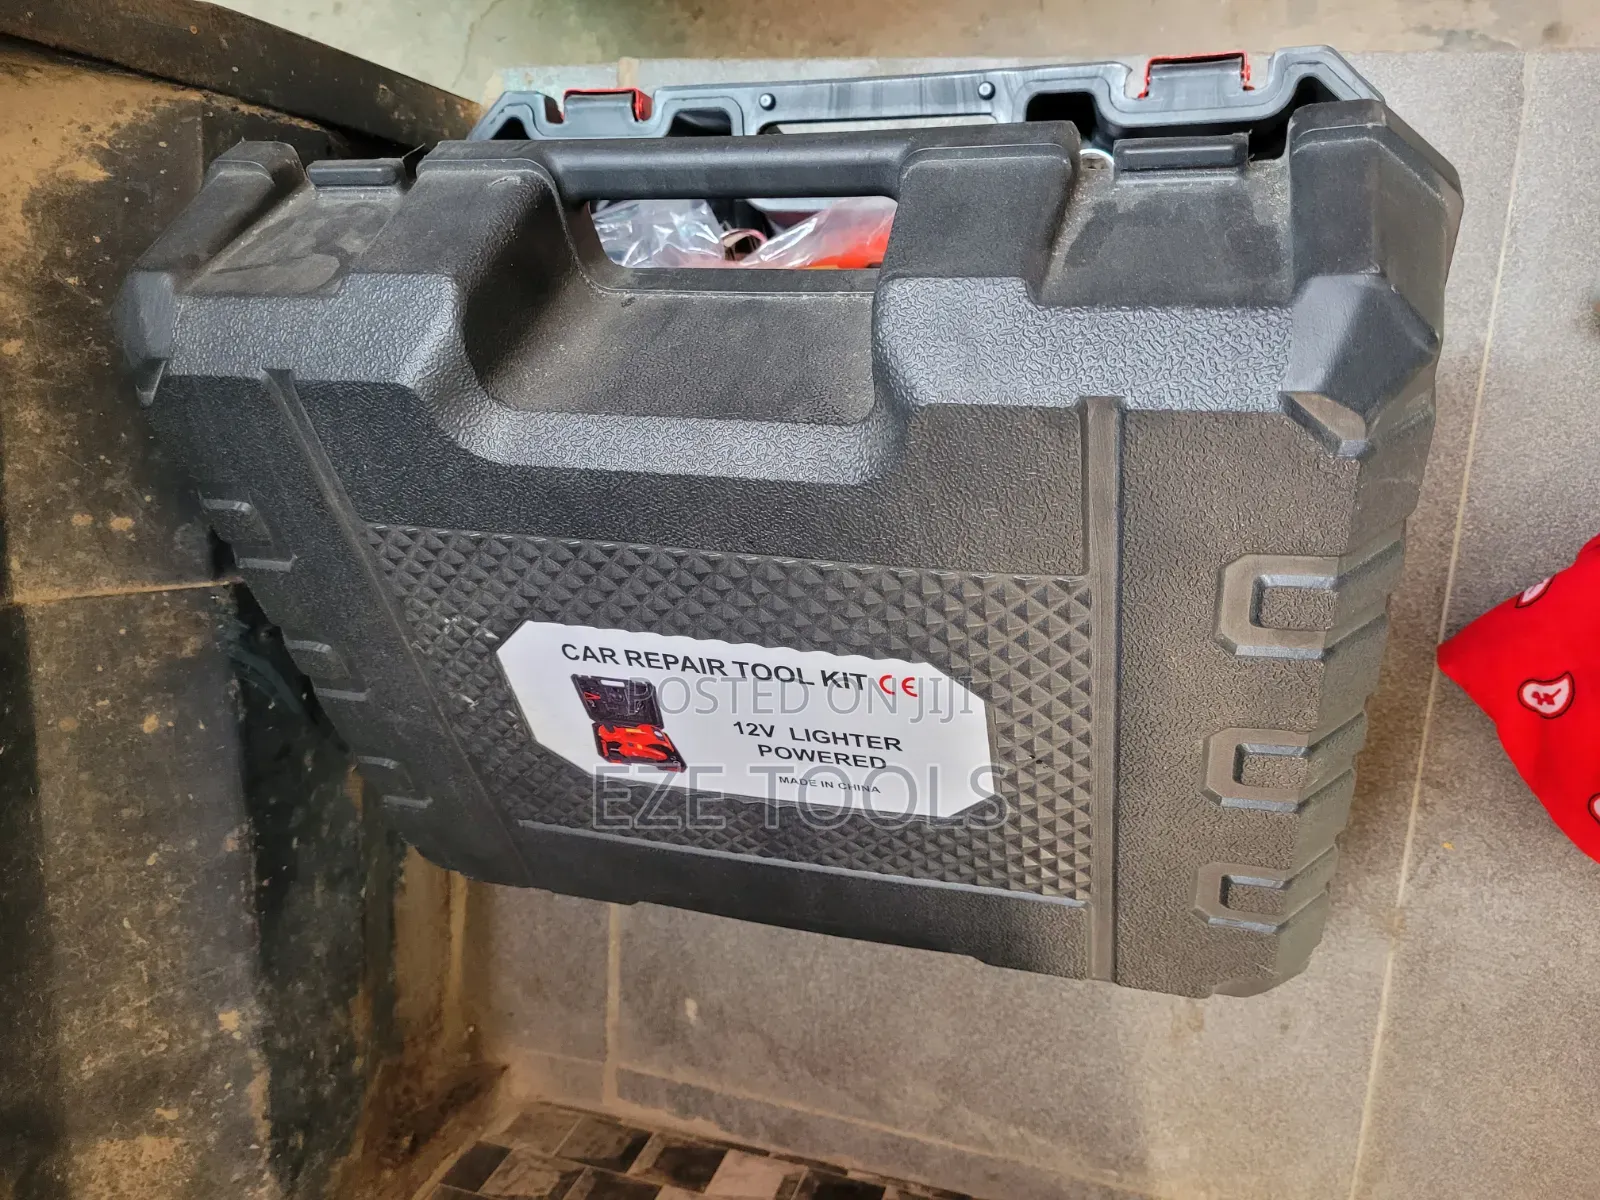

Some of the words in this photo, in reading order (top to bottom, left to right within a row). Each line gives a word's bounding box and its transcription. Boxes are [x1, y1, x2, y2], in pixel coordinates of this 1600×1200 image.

[561, 643, 620, 666] CAR
[623, 649, 728, 676] REPAIR
[732, 660, 815, 686] TOOL
[820, 669, 867, 691] KIT
[733, 721, 775, 738] 12V
[789, 727, 903, 751] LIGHTER
[757, 744, 887, 769] POWERED
[779, 776, 817, 788] MADE
[821, 780, 834, 789] IN
[838, 782, 881, 794] CHINA
